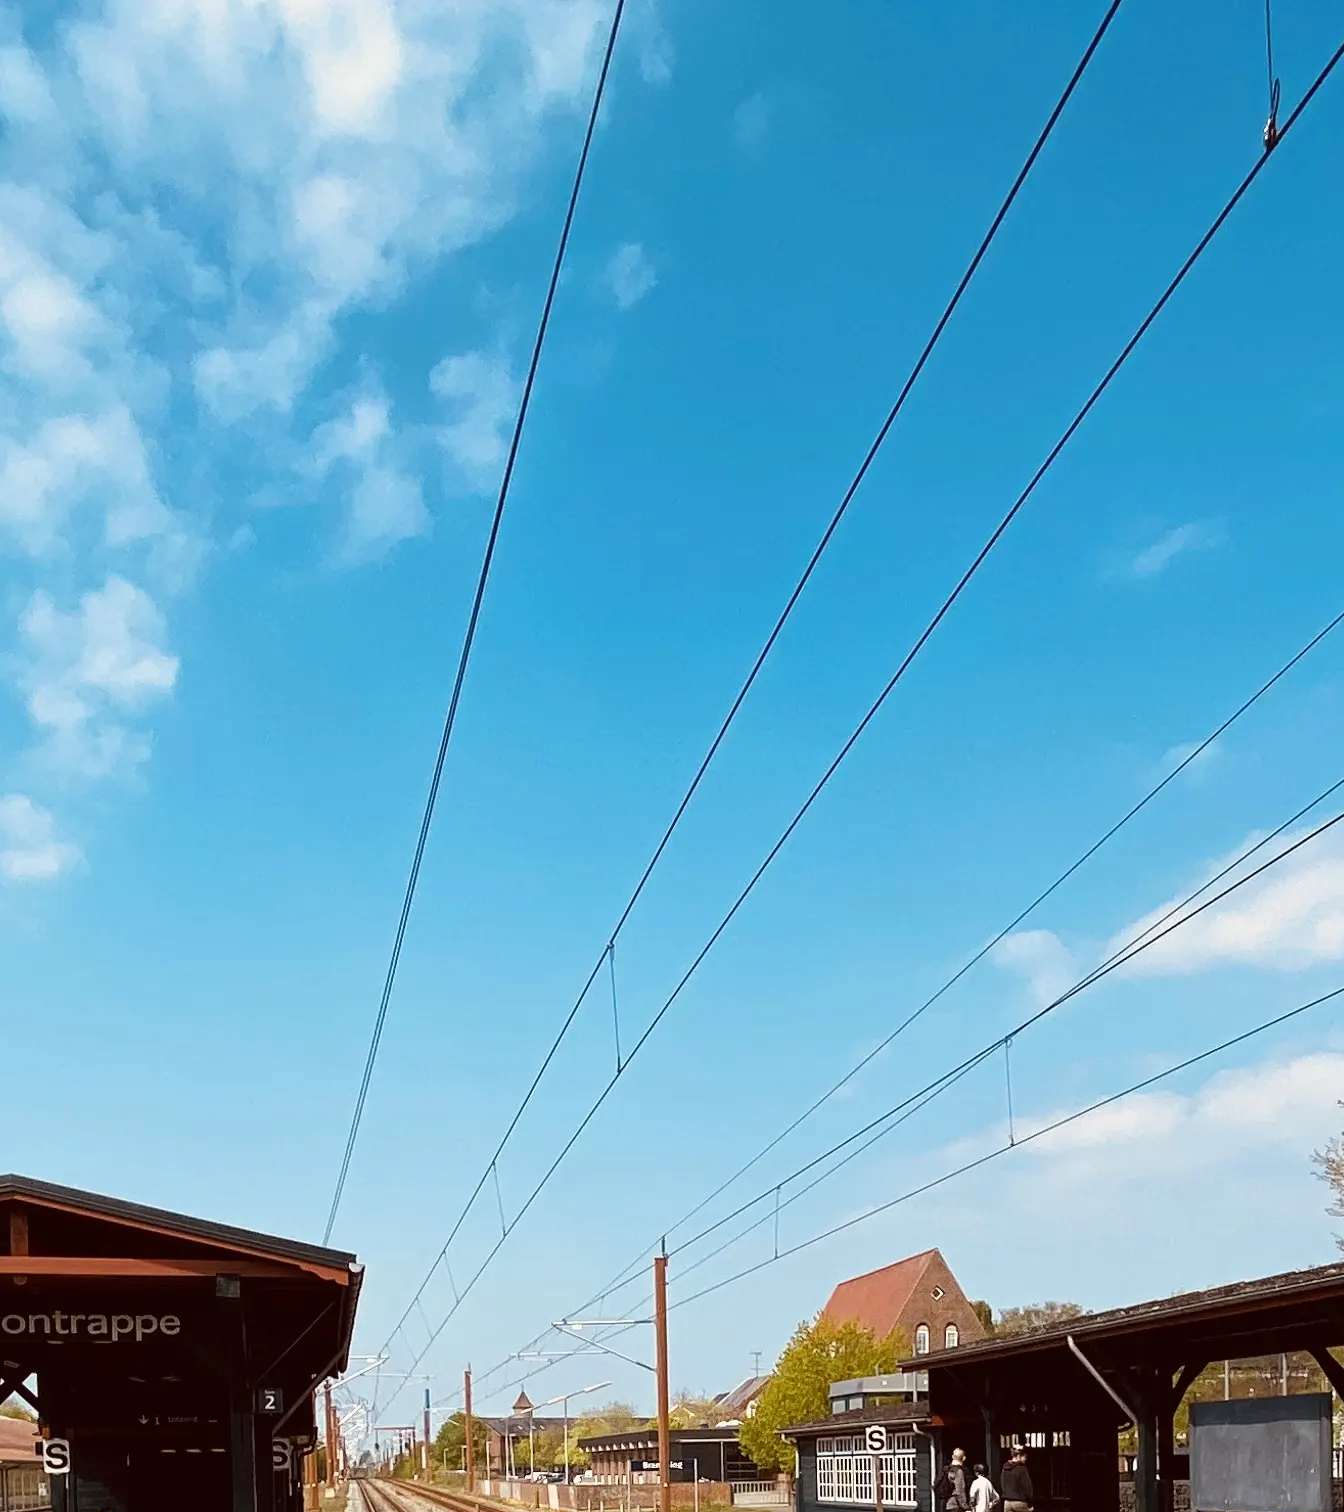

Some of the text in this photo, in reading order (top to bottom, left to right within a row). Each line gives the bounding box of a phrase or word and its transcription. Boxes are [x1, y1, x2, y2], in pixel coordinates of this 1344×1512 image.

[264, 1395, 276, 1410] 2
[868, 1430, 885, 1451] S
[45, 1443, 68, 1469] S
